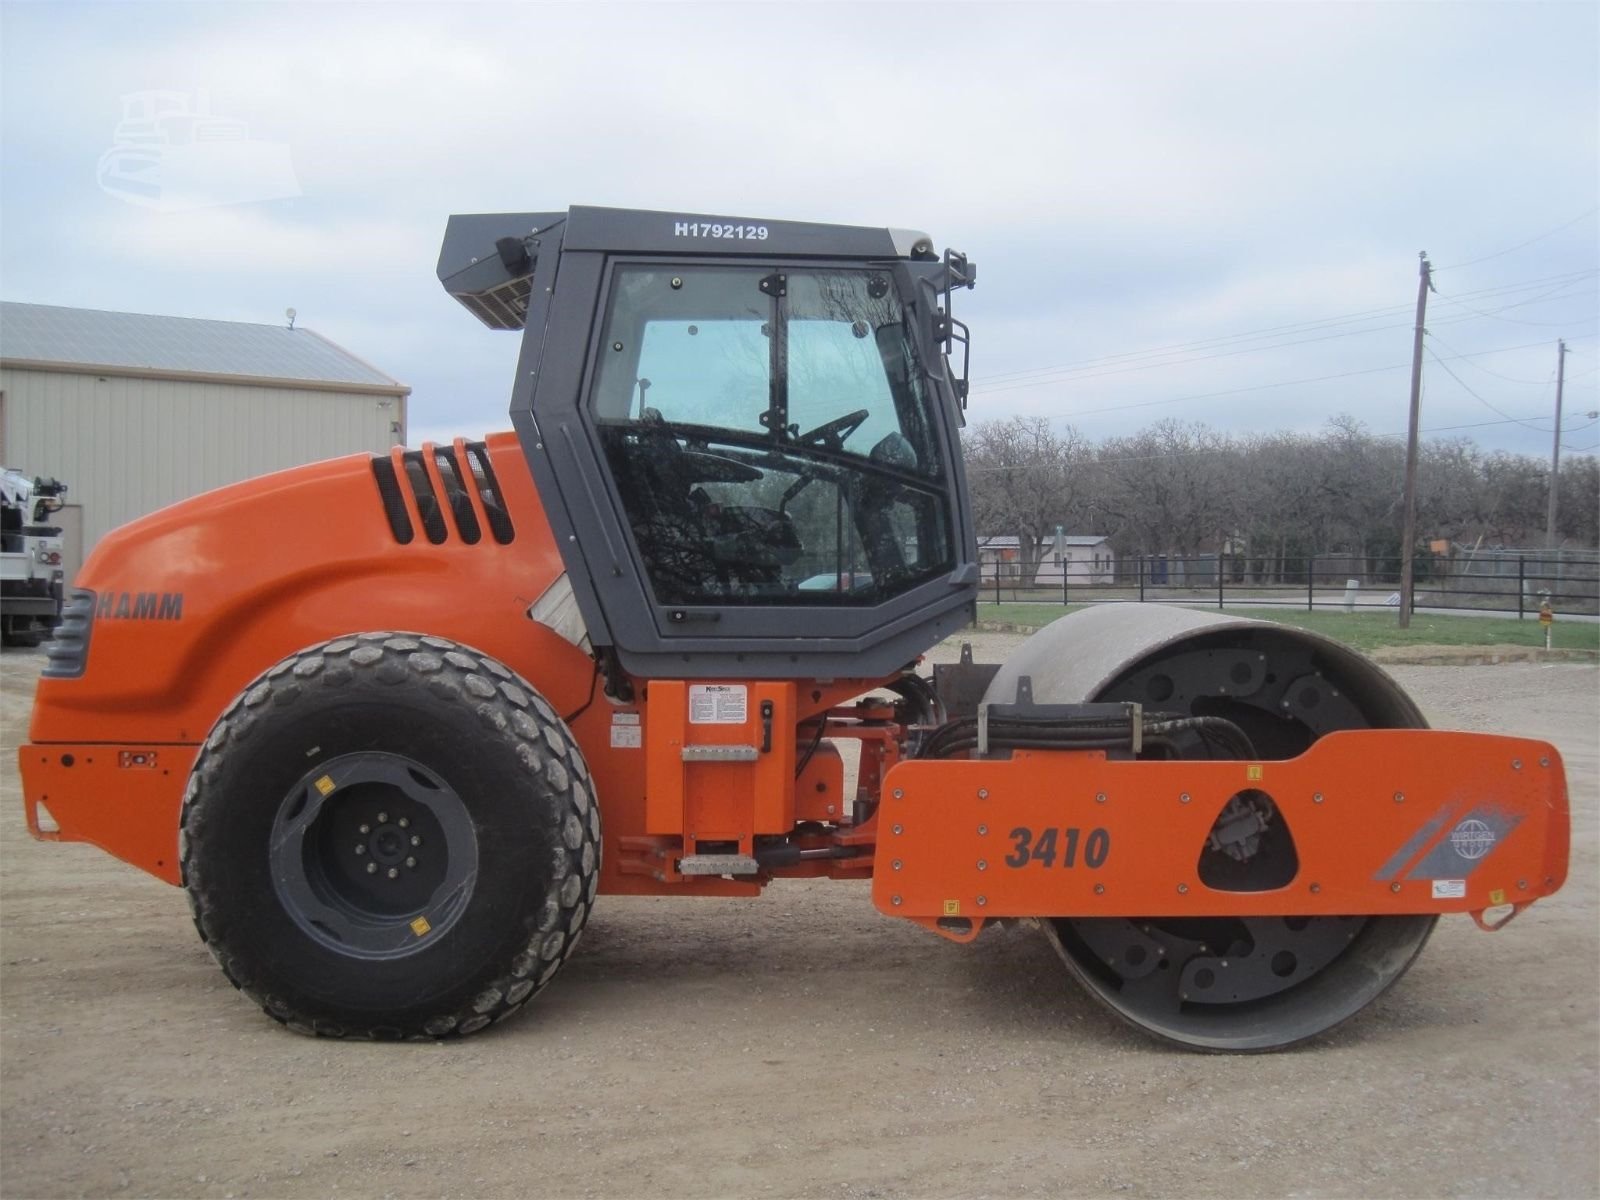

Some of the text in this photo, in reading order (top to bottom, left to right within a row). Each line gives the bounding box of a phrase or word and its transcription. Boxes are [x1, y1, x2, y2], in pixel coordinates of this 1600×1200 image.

[674, 222, 769, 240] H1792129
[96, 592, 184, 620] HAMM
[1451, 831, 1495, 840] WIRTGEN
[1005, 827, 1110, 869] 3410
